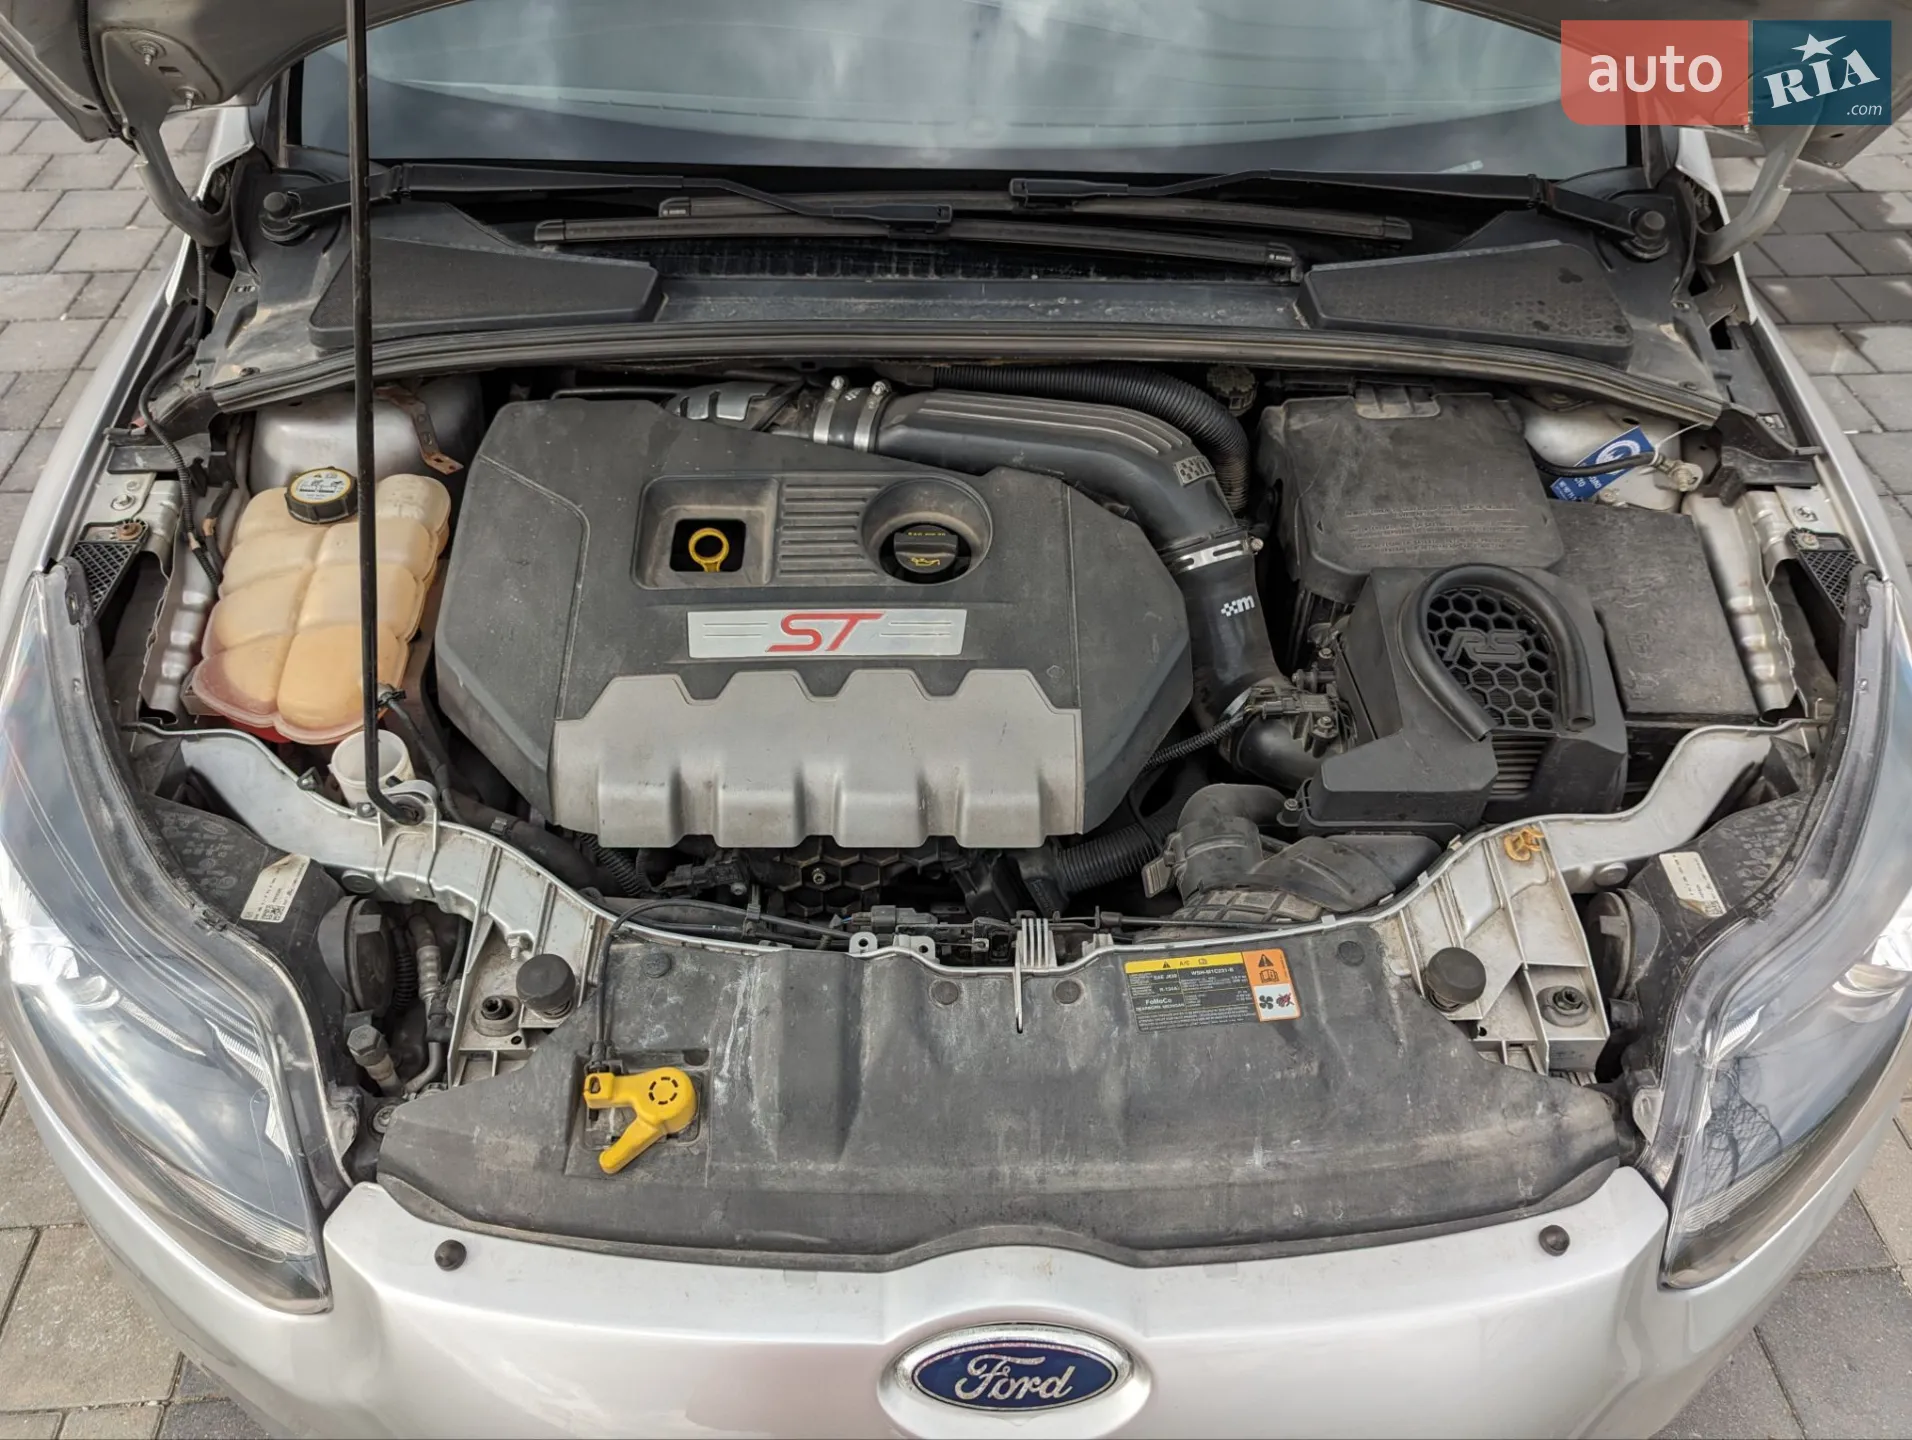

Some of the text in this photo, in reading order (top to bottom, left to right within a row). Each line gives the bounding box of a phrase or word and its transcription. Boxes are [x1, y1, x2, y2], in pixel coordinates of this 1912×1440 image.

[765, 612, 886, 653] ST
[1442, 627, 1528, 664] RS
[1145, 997, 1172, 1005] FoMoCo
[954, 1354, 1076, 1400] Ford
